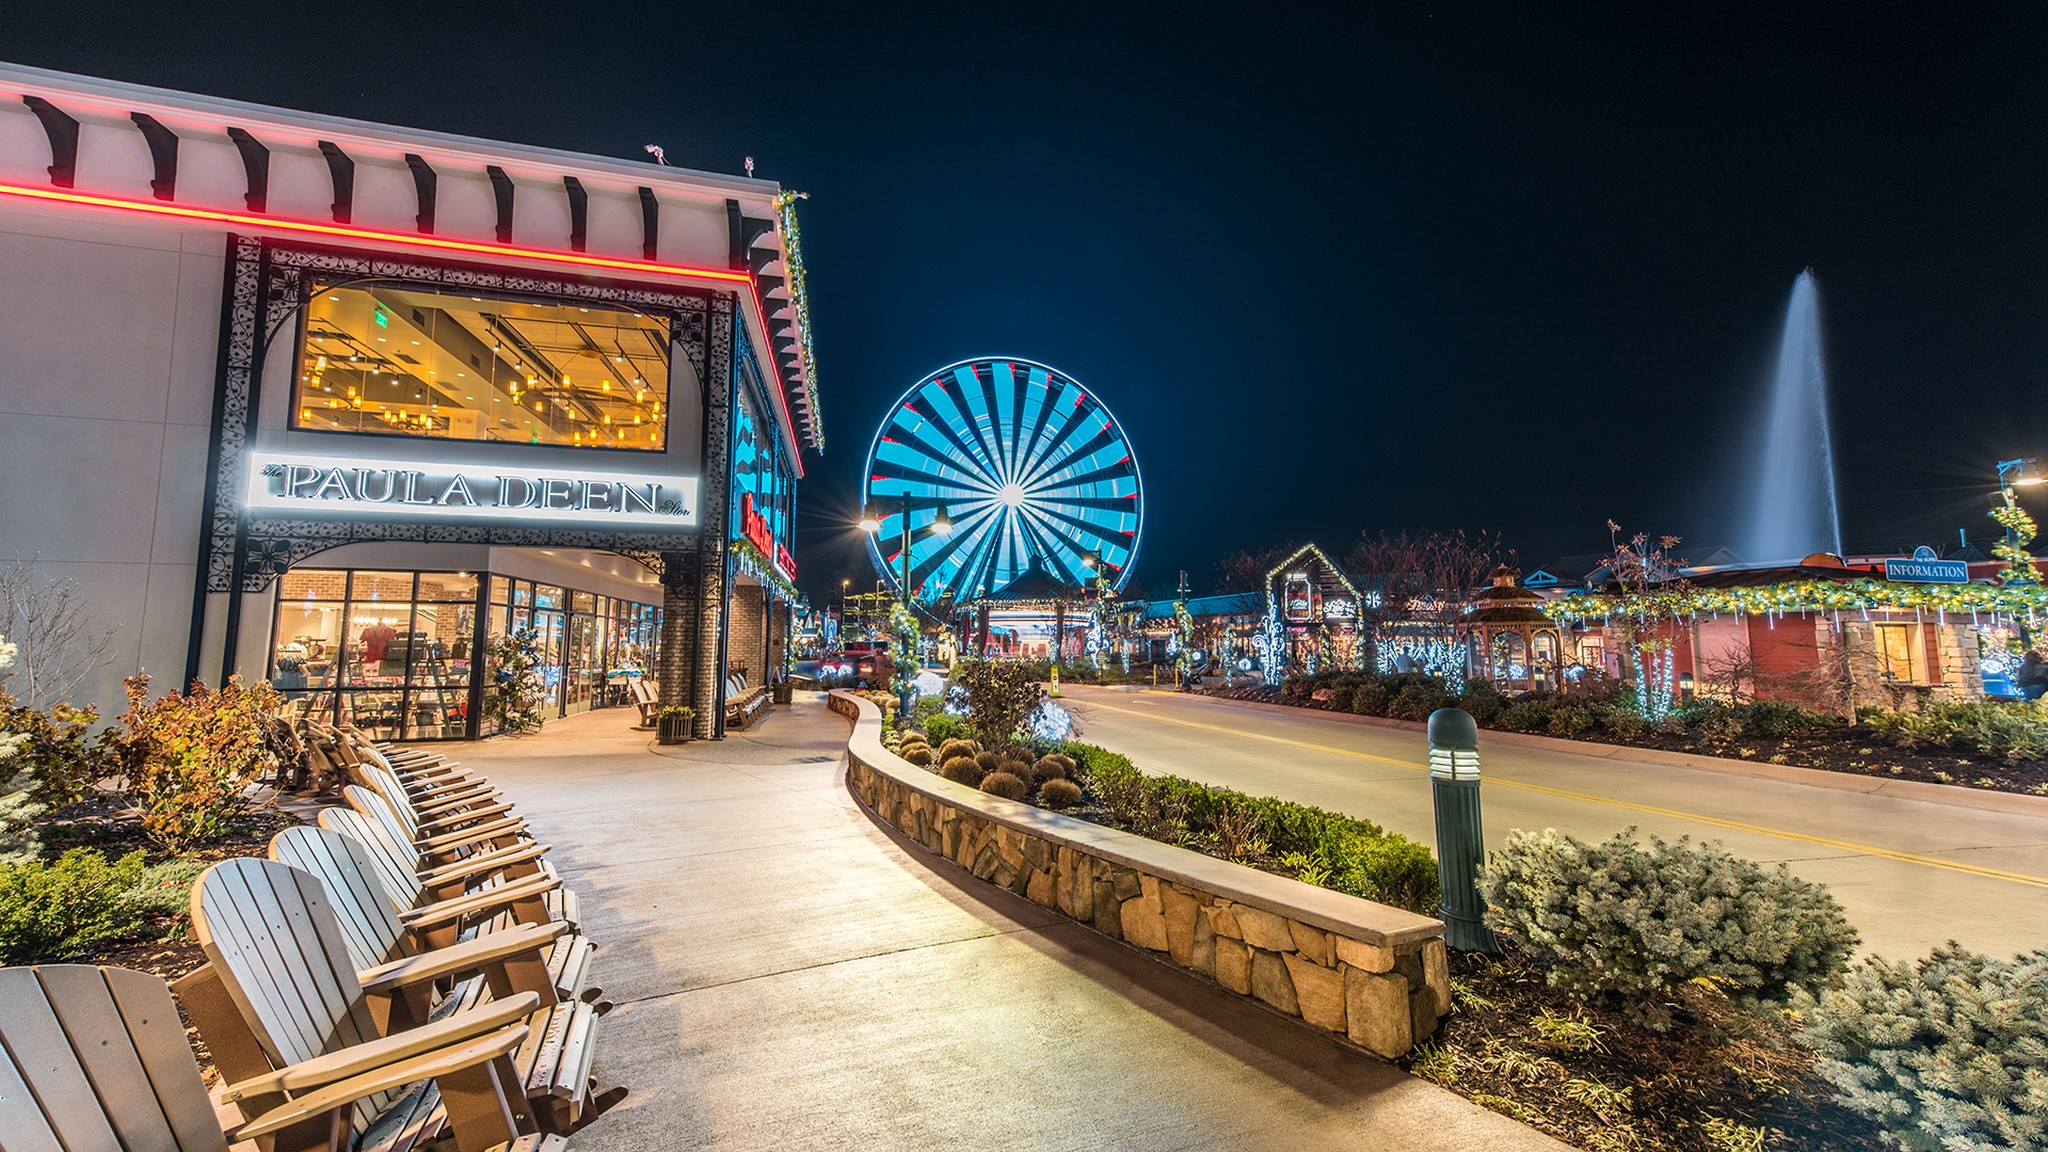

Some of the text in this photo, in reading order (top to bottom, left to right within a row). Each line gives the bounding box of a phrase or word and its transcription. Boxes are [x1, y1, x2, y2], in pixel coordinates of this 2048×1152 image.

[260, 464, 283, 477] The
[278, 464, 482, 507] PAULA
[492, 475, 663, 514] DEEN
[1889, 564, 1965, 577] INFORMATION
